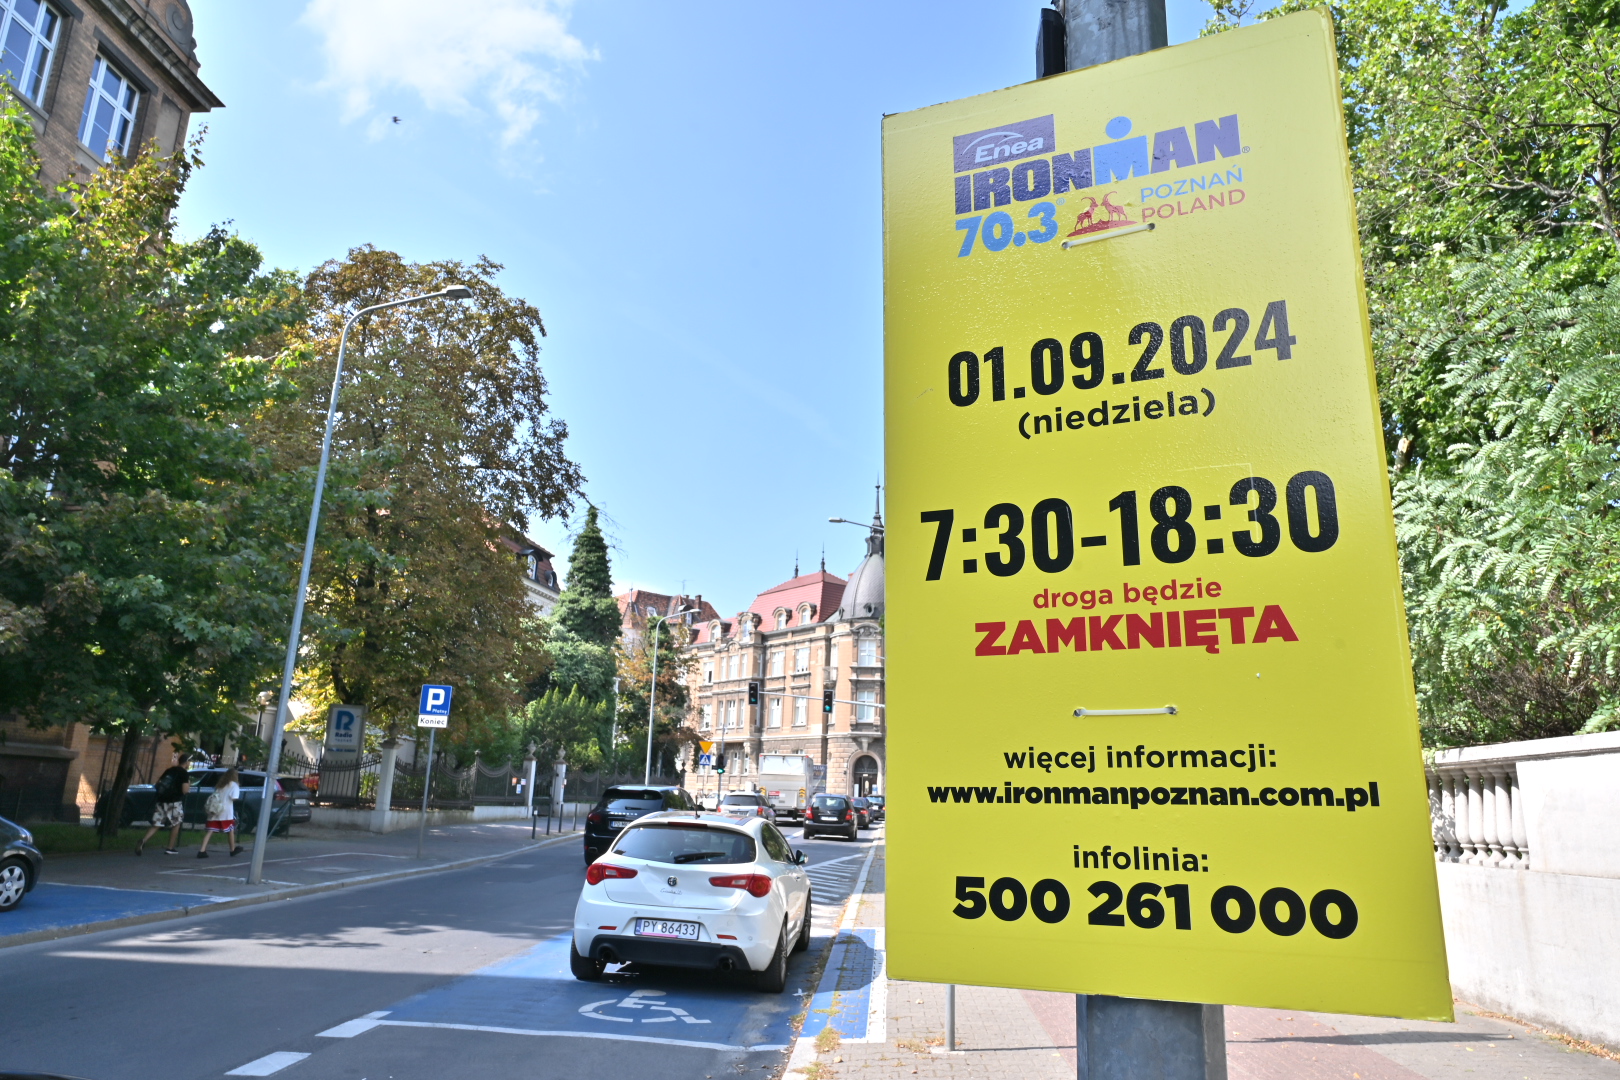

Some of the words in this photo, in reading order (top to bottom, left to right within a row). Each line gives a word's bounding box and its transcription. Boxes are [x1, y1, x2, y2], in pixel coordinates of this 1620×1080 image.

[954, 113, 1242, 215] IRONMAN
[974, 135, 1044, 164] Enea
[1140, 164, 1244, 203] POZNAŃ
[1141, 189, 1246, 222] POLAND
[955, 201, 1059, 258] 70.3
[947, 299, 1297, 407] 01.09.2024
[1018, 387, 1216, 439] (niedziela)
[920, 470, 1340, 581] 7:30-18:30
[1032, 588, 1114, 610] droga
[1123, 577, 1222, 606] będzie
[975, 604, 1300, 655] ZAMKNIĘTA
[426, 688, 445, 711] P
[420, 717, 446, 726] Koniec
[1004, 746, 1096, 773] więcej
[1106, 743, 1278, 773] informacji:
[927, 781, 1380, 812] www.ironmanpoznan.com.pl
[1073, 845, 1210, 873] infolinia:
[952, 876, 1071, 924] 500
[1087, 880, 1192, 931] 261
[1210, 885, 1359, 940] 000
[643, 920, 658, 932] PY
[661, 922, 696, 936] 86433
